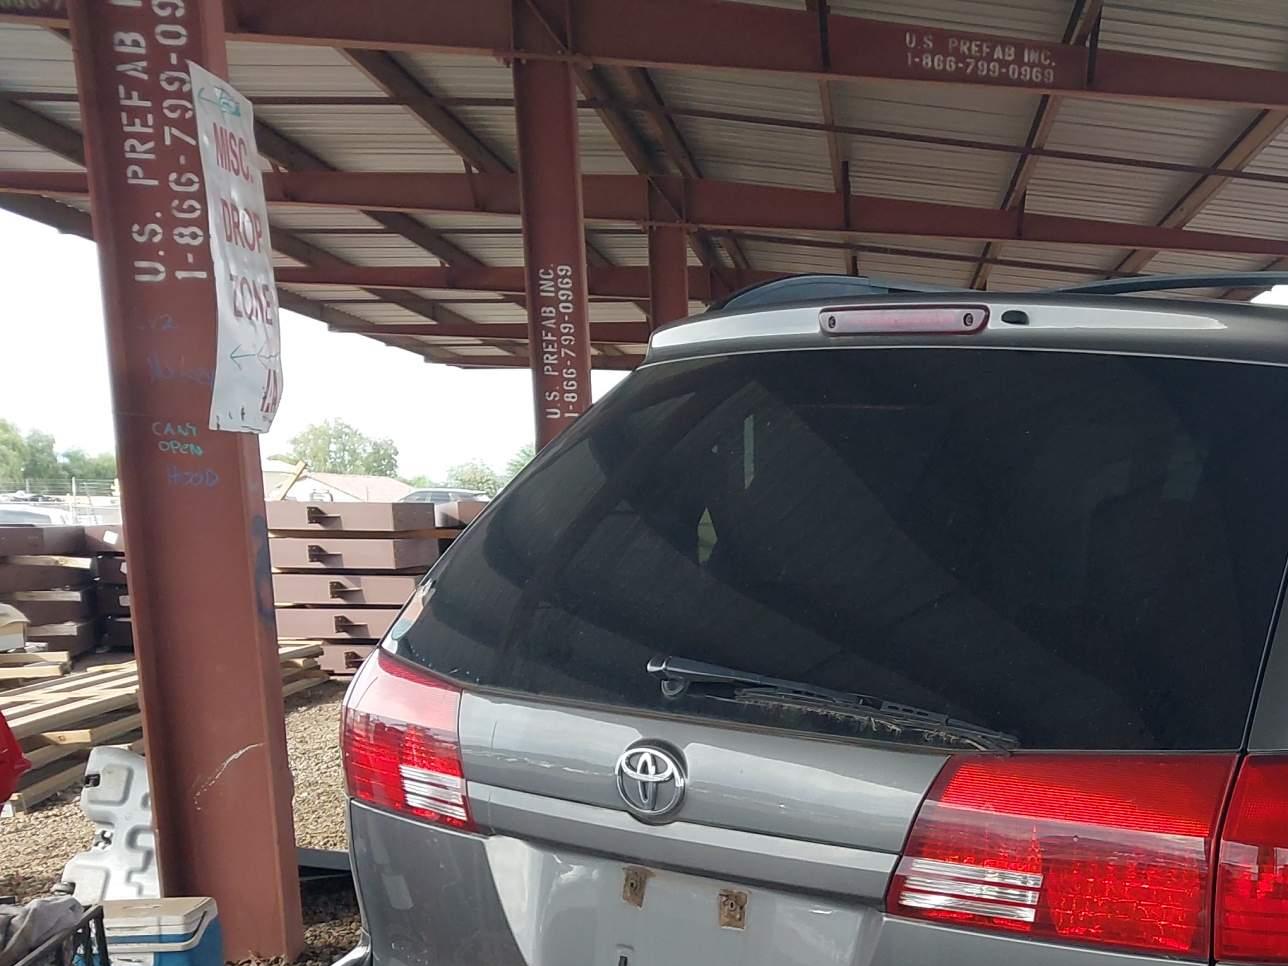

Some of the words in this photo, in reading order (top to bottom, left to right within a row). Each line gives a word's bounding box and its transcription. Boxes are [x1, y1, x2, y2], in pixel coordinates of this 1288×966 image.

[905, 52, 1055, 84] 1-866-799-0969
[948, 38, 1015, 61] PREFAB
[1023, 48, 1057, 67] INC.
[112, 31, 159, 187] PREFAB
[131, 211, 167, 282] U.S.
[220, 198, 263, 254] DROP
[229, 273, 274, 325] ZONE
[539, 263, 556, 297] INC.
[541, 306, 559, 376] PREFAB
[556, 264, 580, 417] 1-866-799-0969
[545, 386, 561, 419] U.S.
